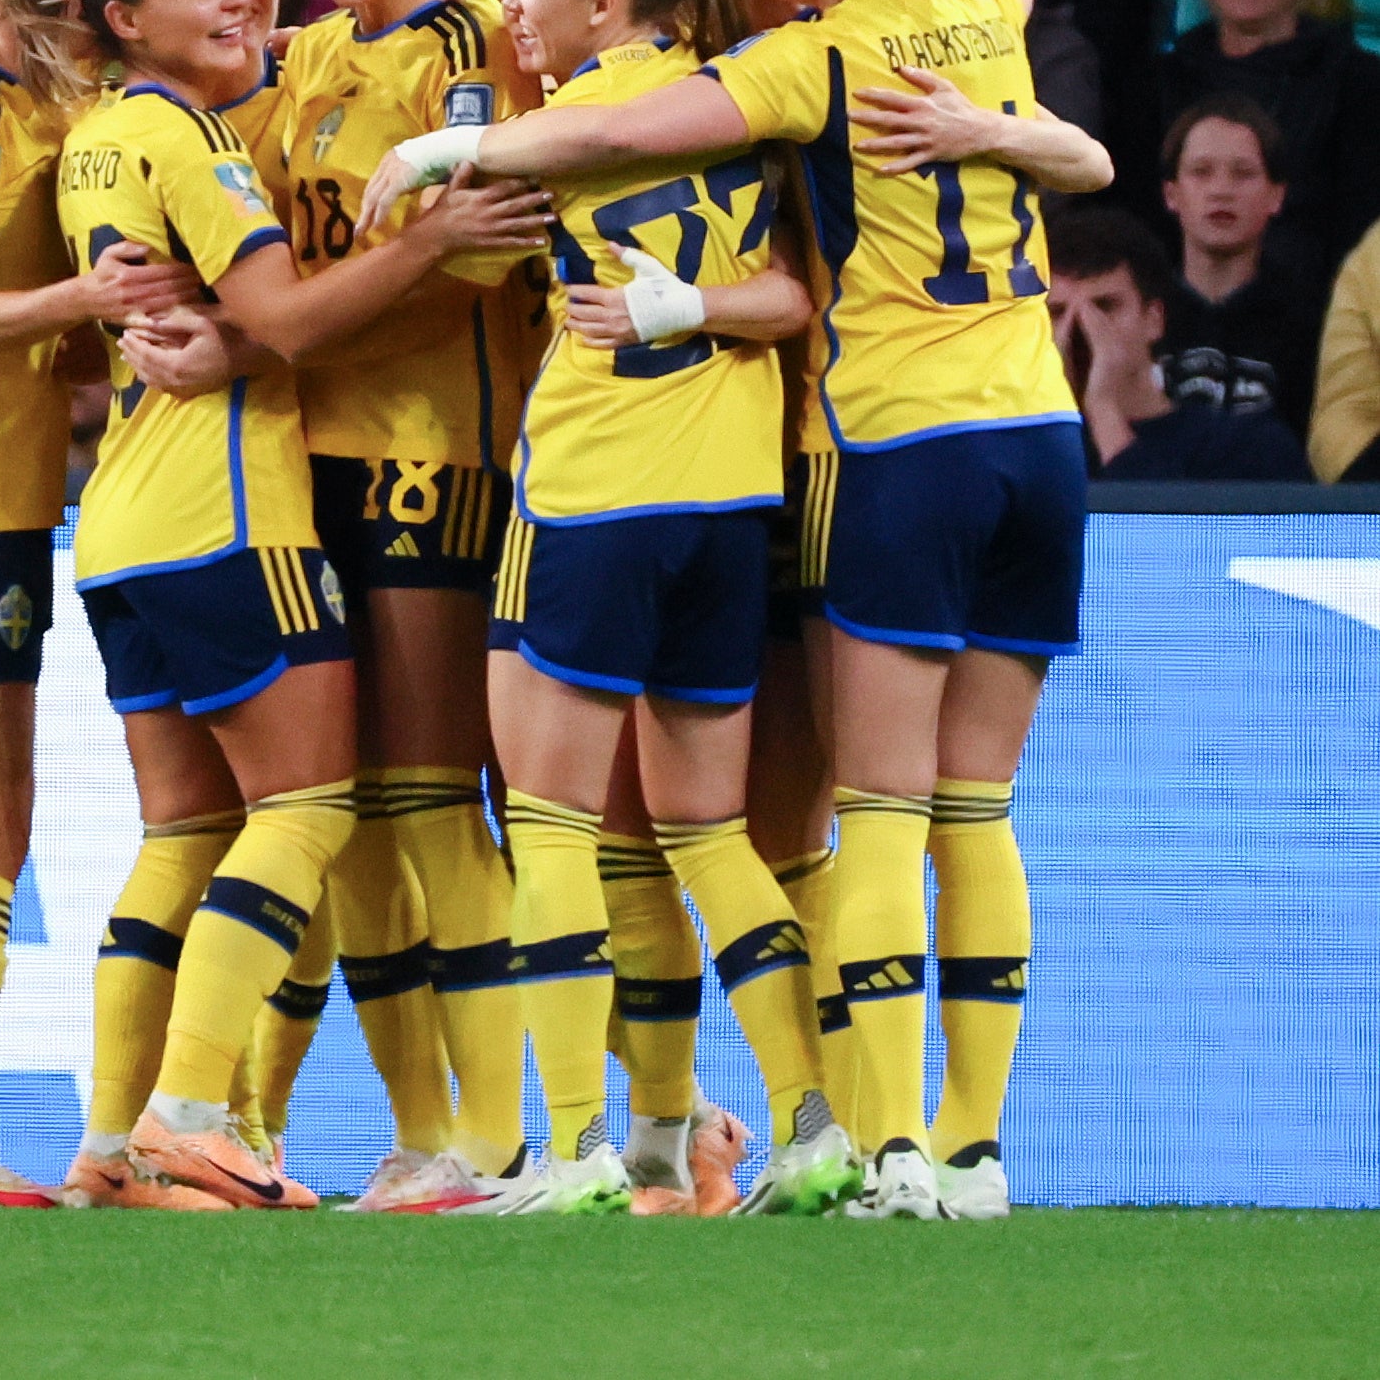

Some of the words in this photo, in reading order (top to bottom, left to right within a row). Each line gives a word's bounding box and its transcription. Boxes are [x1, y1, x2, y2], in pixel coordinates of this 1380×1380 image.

[297, 178, 355, 261] 18
[917, 100, 1048, 305] 11
[363, 459, 440, 525] 18
